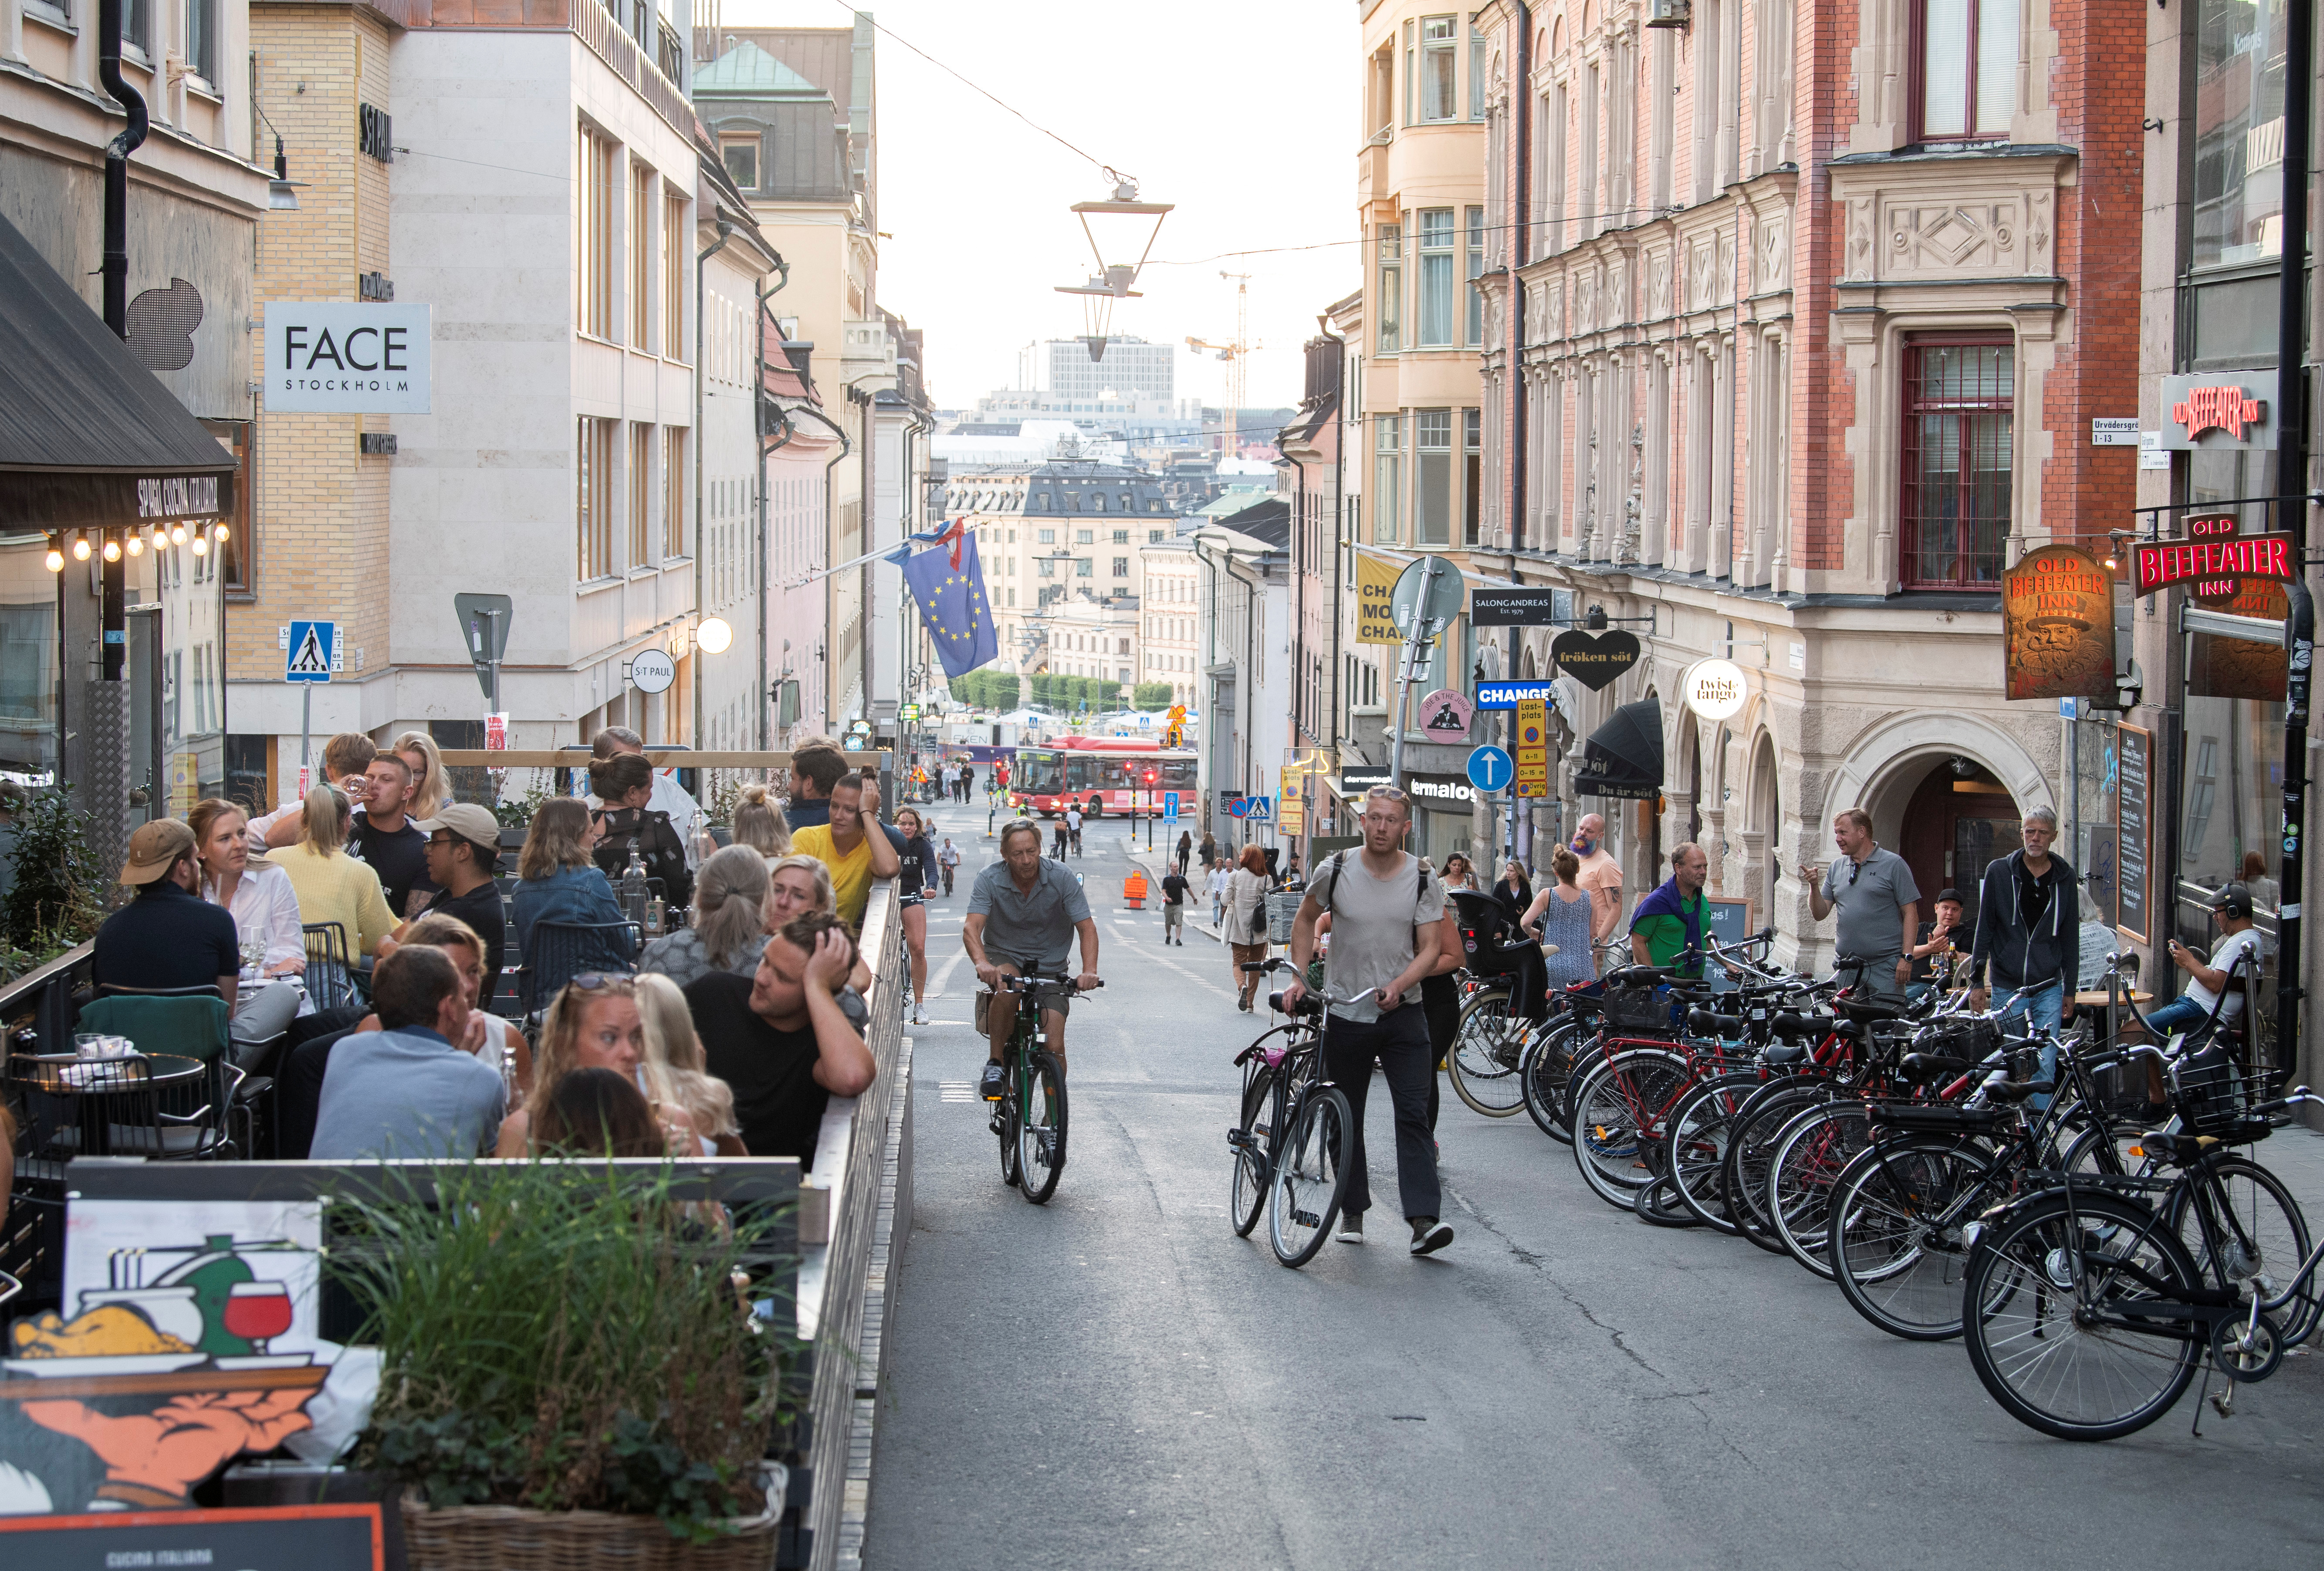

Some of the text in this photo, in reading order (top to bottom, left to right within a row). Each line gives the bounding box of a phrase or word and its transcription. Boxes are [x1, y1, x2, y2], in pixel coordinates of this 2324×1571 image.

[286, 326, 407, 371] FACE
[286, 379, 408, 391] STOCKHOLM
[2173, 386, 2258, 441] OLD BEEFEATER INN
[367, 433, 397, 455] HOLY GREENS
[138, 477, 218, 517] SPAGO CUCINA ITALIANA
[2193, 520, 2233, 535] OLD
[2036, 558, 2078, 573] OLD
[2140, 538, 2290, 588] BEEFEATER
[1363, 584, 1393, 598] CH
[2010, 574, 2105, 598] BEEFEATER
[2200, 580, 2233, 596] INN
[2038, 594, 2077, 608] INN
[1363, 604, 1391, 619] MO
[1560, 652, 1632, 662] fröken söt
[636, 667, 670, 676] S:T PAUL
[1701, 677, 1732, 690] twist
[1479, 689, 1549, 702] CHANGE
[1698, 689, 1736, 703] tango
[1424, 698, 1435, 711] JOE
[1455, 697, 1470, 713] JUICE
[1522, 712, 1541, 720] plats
[954, 735, 987, 743] EKEN
[1598, 784, 1614, 795] Du
[1617, 787, 1631, 796] är
[1634, 788, 1653, 797] söt
[1711, 909, 1729, 921] ps!
